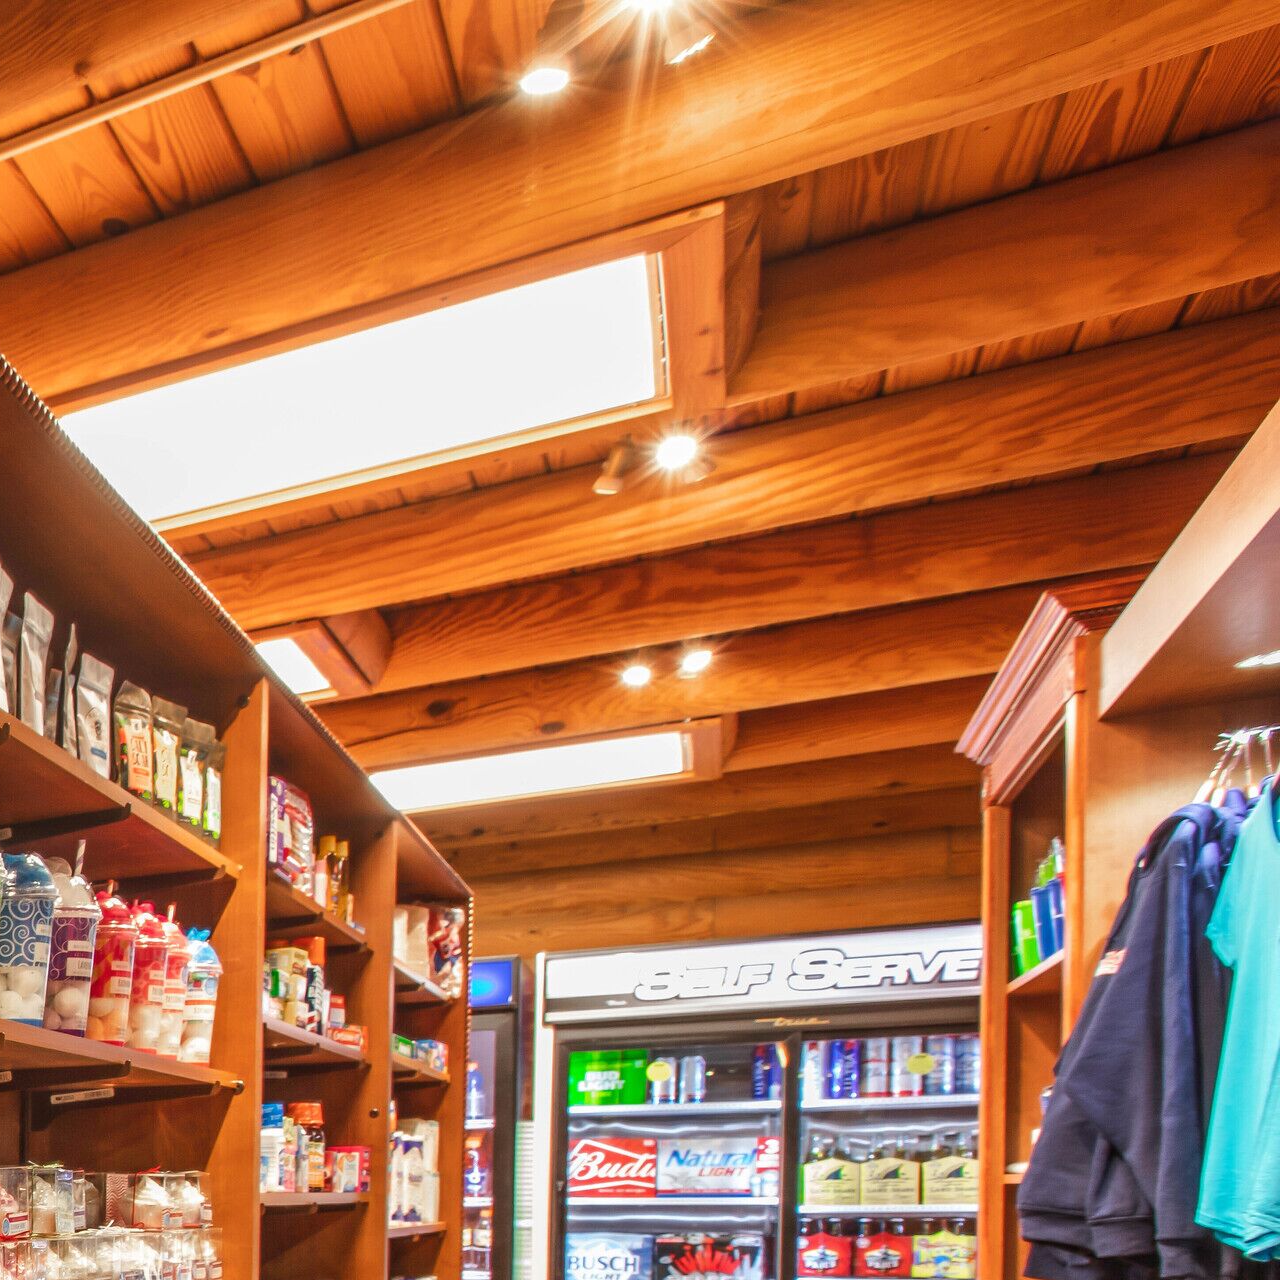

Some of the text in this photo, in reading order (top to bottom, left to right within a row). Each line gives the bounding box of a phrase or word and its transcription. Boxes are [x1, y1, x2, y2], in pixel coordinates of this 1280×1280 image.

[634, 948, 981, 1001] SELF SERVE
[666, 1148, 759, 1168] Natural
[567, 1253, 638, 1275] BUSCH
